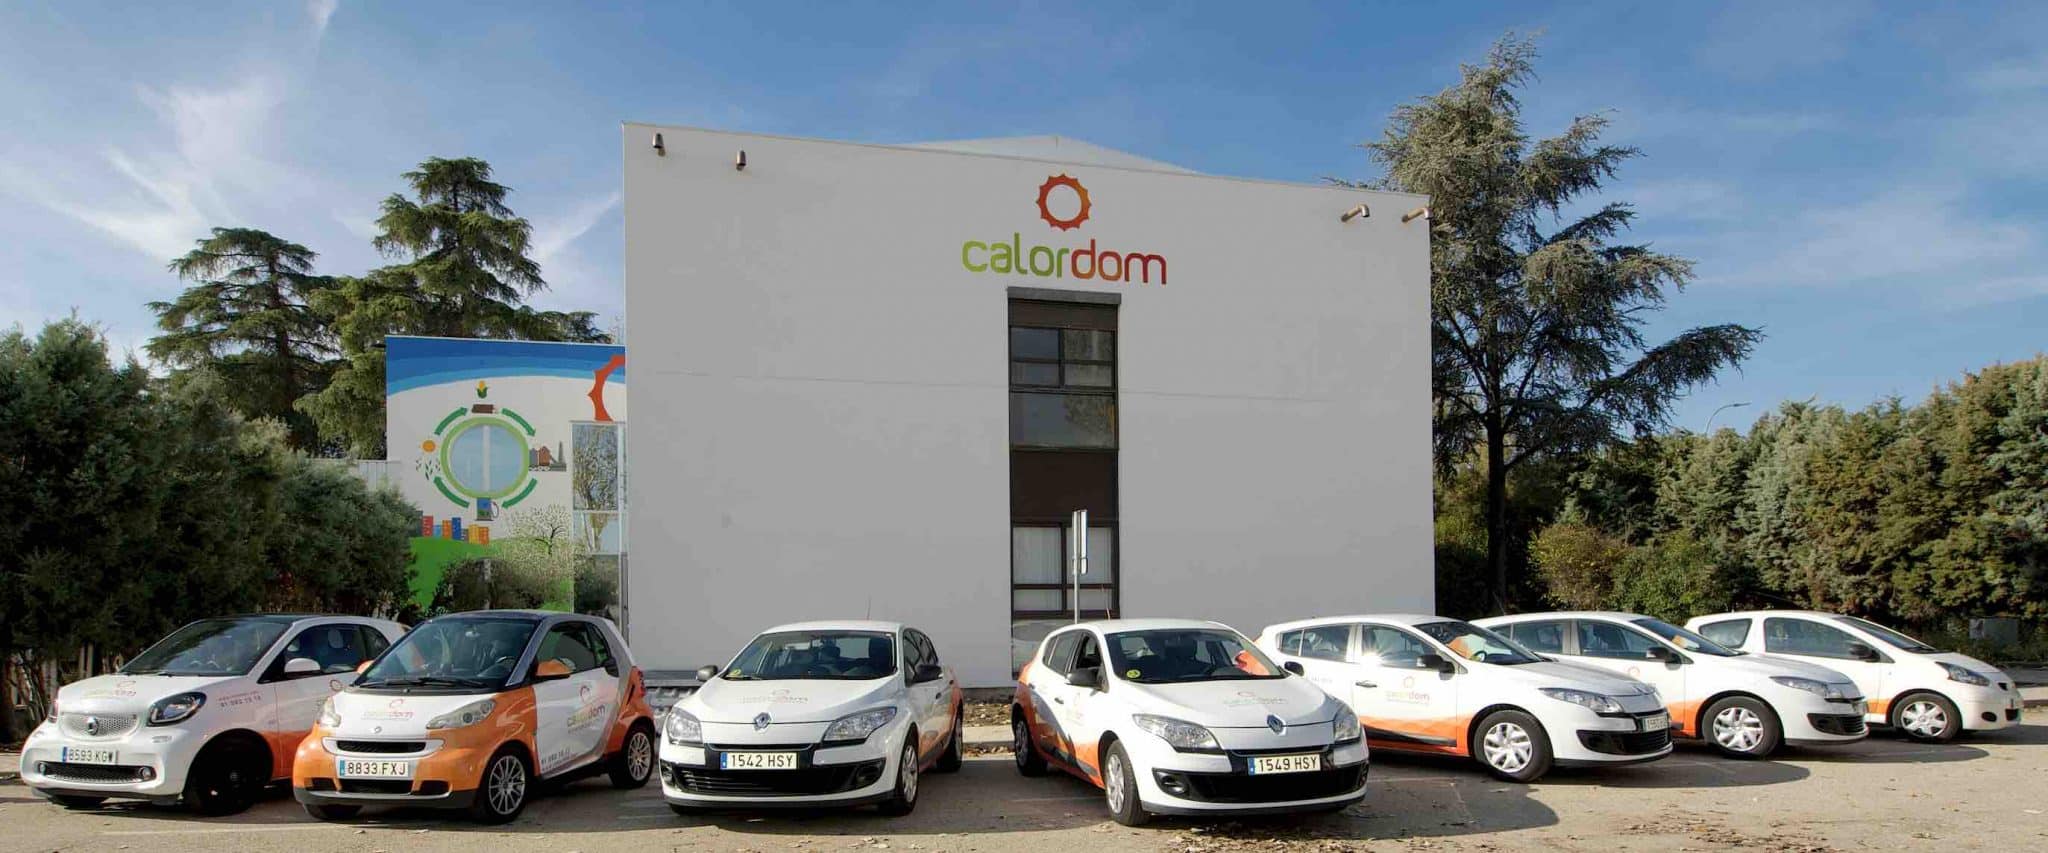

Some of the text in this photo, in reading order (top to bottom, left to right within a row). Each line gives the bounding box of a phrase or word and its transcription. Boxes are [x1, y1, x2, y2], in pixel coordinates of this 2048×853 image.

[961, 232, 1167, 285] calordom
[732, 754, 793, 767] 1542 HSY
[1259, 756, 1317, 772] 1549 HSY
[347, 762, 406, 775] 8833 FXJ
